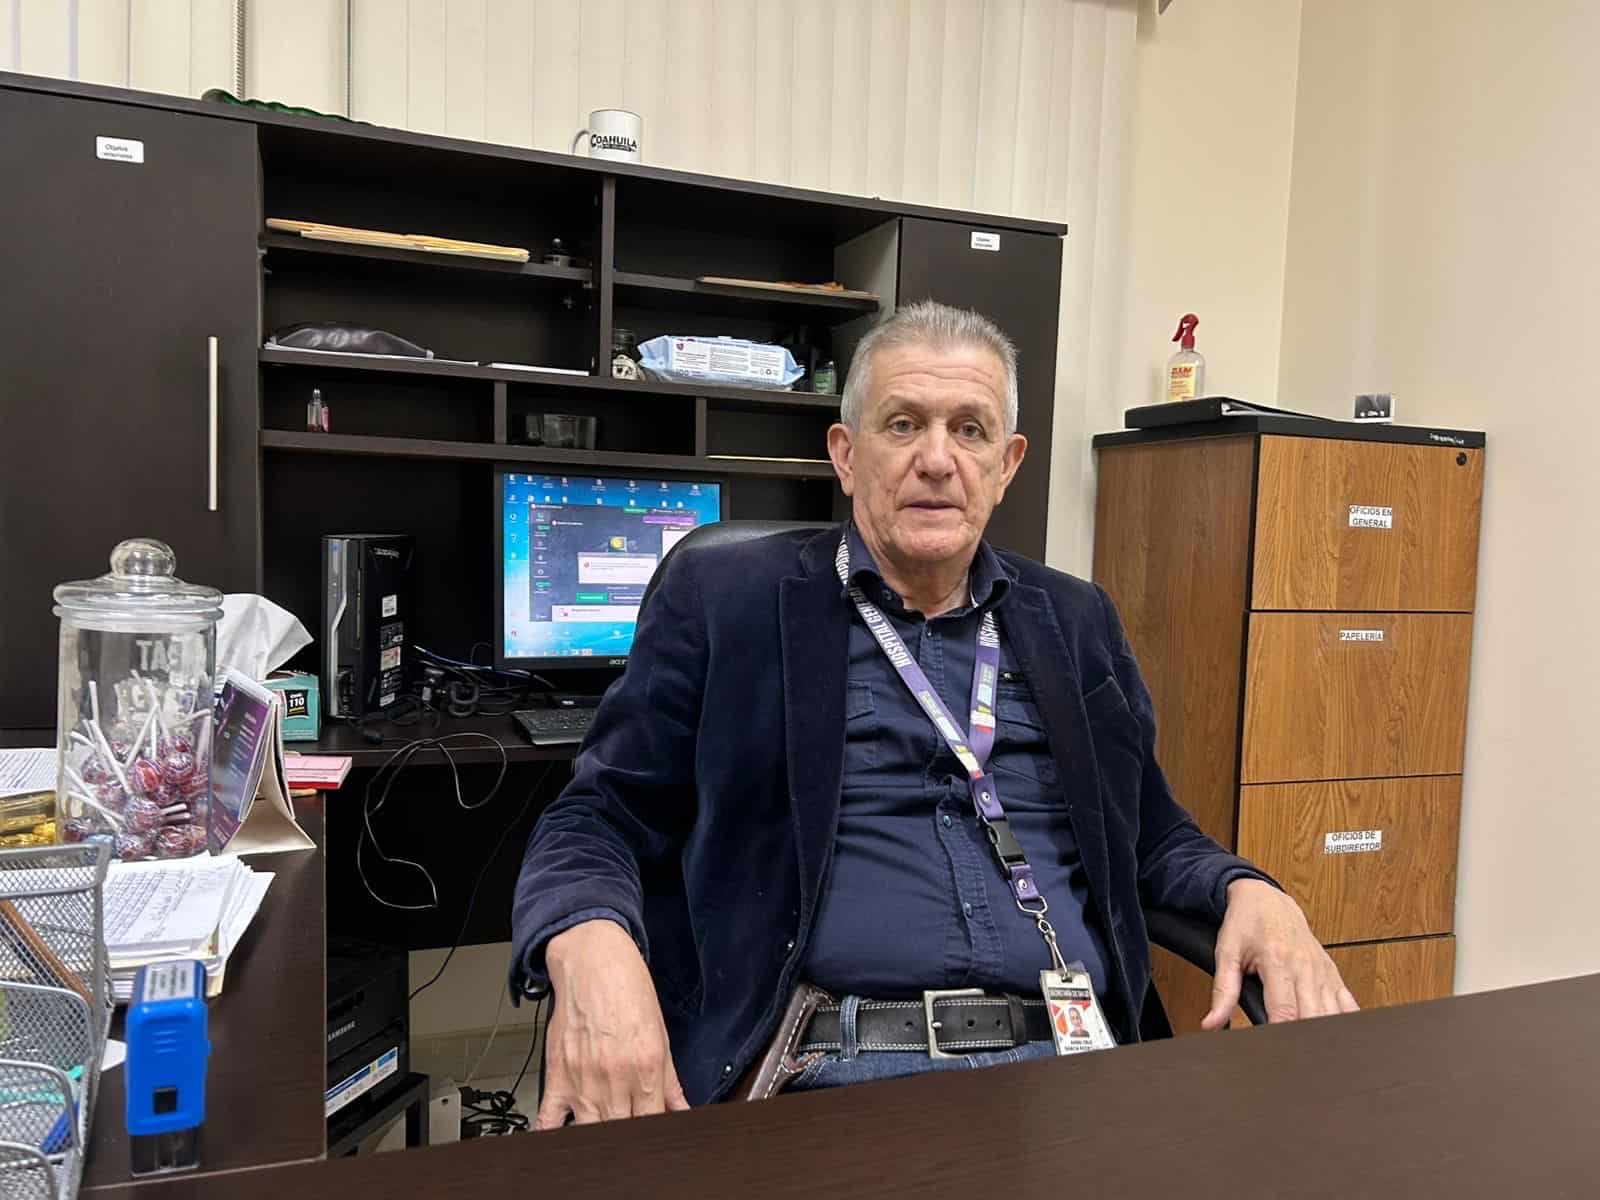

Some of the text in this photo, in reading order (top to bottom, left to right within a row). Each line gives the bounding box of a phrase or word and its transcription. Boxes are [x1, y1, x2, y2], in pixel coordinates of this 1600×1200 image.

[590, 134, 637, 150] COAHUILA
[1349, 506, 1380, 516] OFICIOS
[1352, 518, 1387, 528] GENERAL
[872, 621, 913, 668] HOSPITAL
[289, 697, 304, 707] 110
[1331, 831, 1376, 841] OFICIOS DE
[1326, 842, 1380, 852] SUBDIRECTOR
